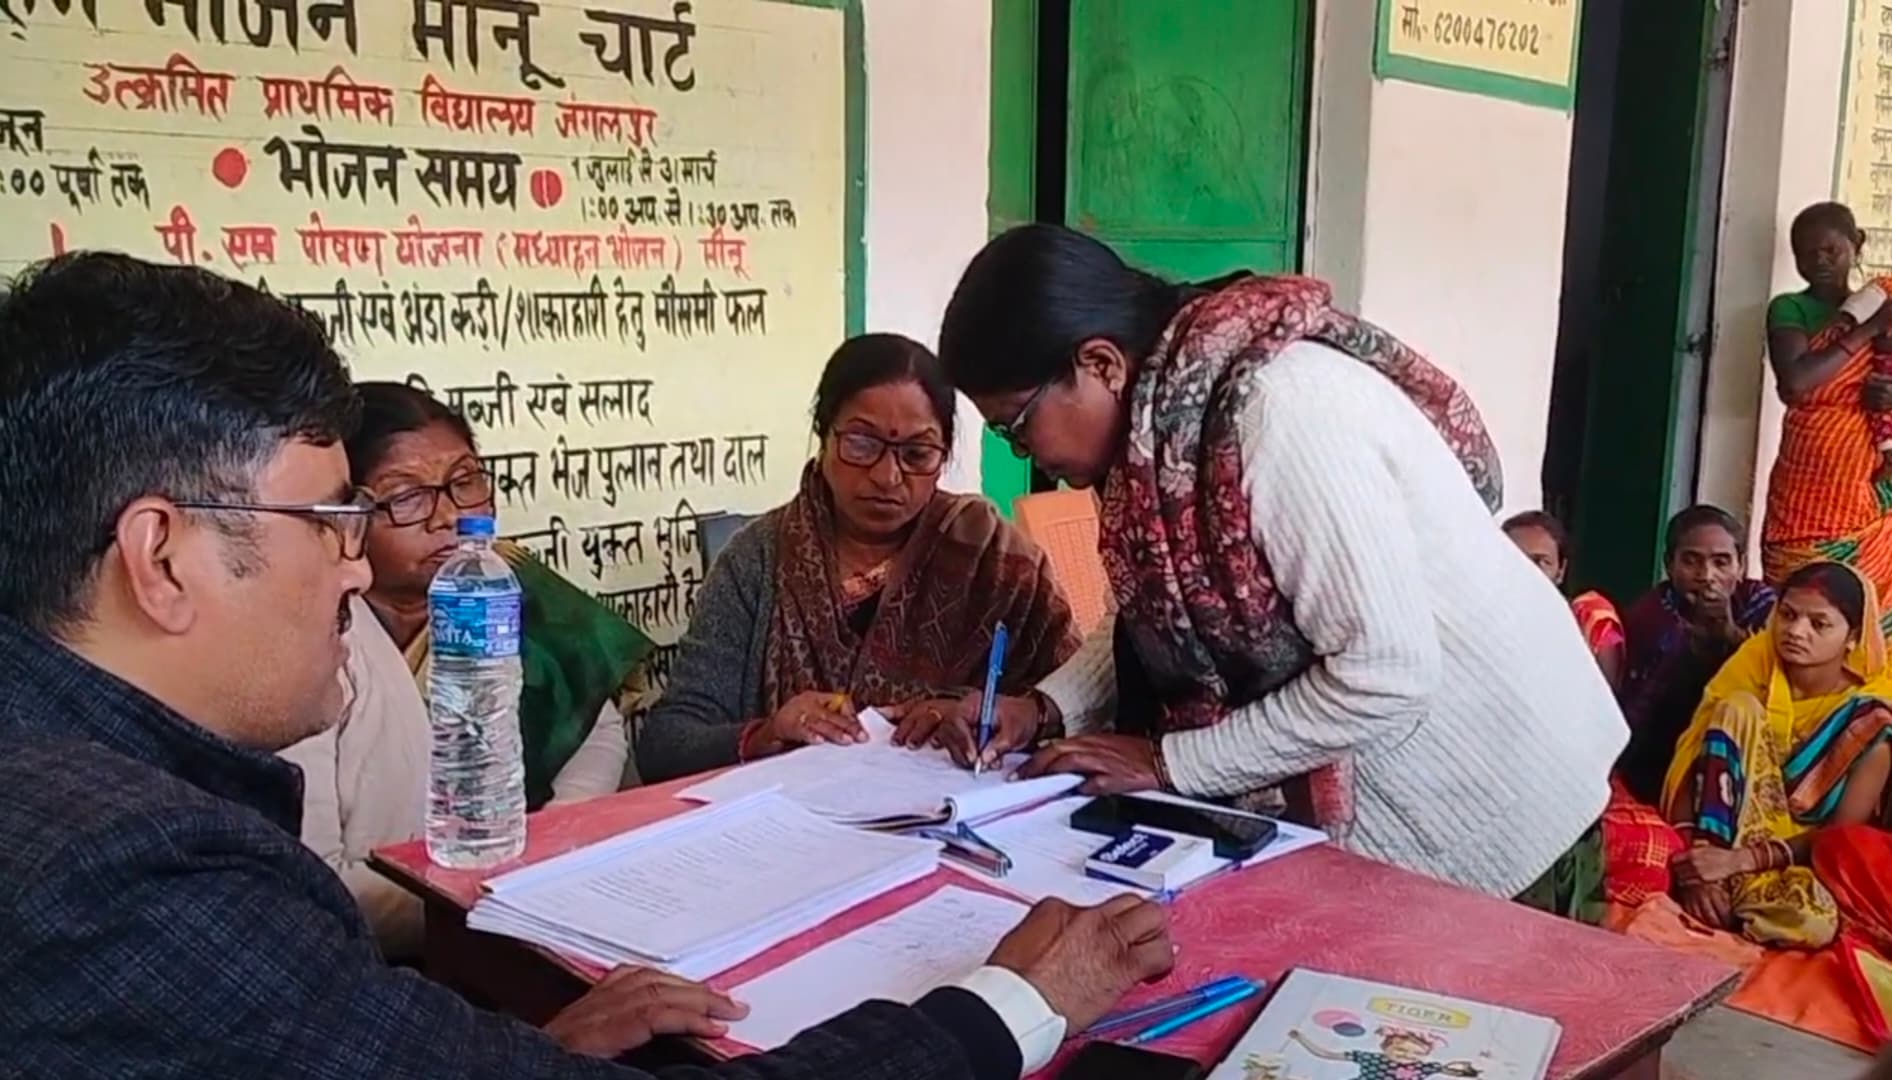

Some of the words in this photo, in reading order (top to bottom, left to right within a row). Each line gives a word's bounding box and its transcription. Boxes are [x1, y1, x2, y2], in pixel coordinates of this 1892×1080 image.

[579, 1, 696, 91] चार्ट
[1434, 11, 1540, 55] 6200476202
[256, 65, 393, 126] प्राथमिक
[419, 74, 535, 137] विद्यालय
[555, 92, 658, 148] जंगलपुर
[109, 163, 151, 211] तक
[263, 124, 407, 206] भोजन
[414, 148, 523, 209] समय
[680, 150, 717, 188] मार्च
[665, 187, 682, 226] से
[769, 199, 797, 229] तक
[295, 211, 387, 277] पोषण
[391, 215, 484, 267] योजना
[698, 227, 751, 280] मीनू
[613, 275, 645, 351] हेतु
[652, 274, 717, 340] मौसमी
[722, 289, 767, 336] फल
[579, 380, 653, 426] सलाद
[670, 438, 714, 489] तथा
[723, 435, 768, 485] दाल
[579, 521, 644, 579] युक्त
